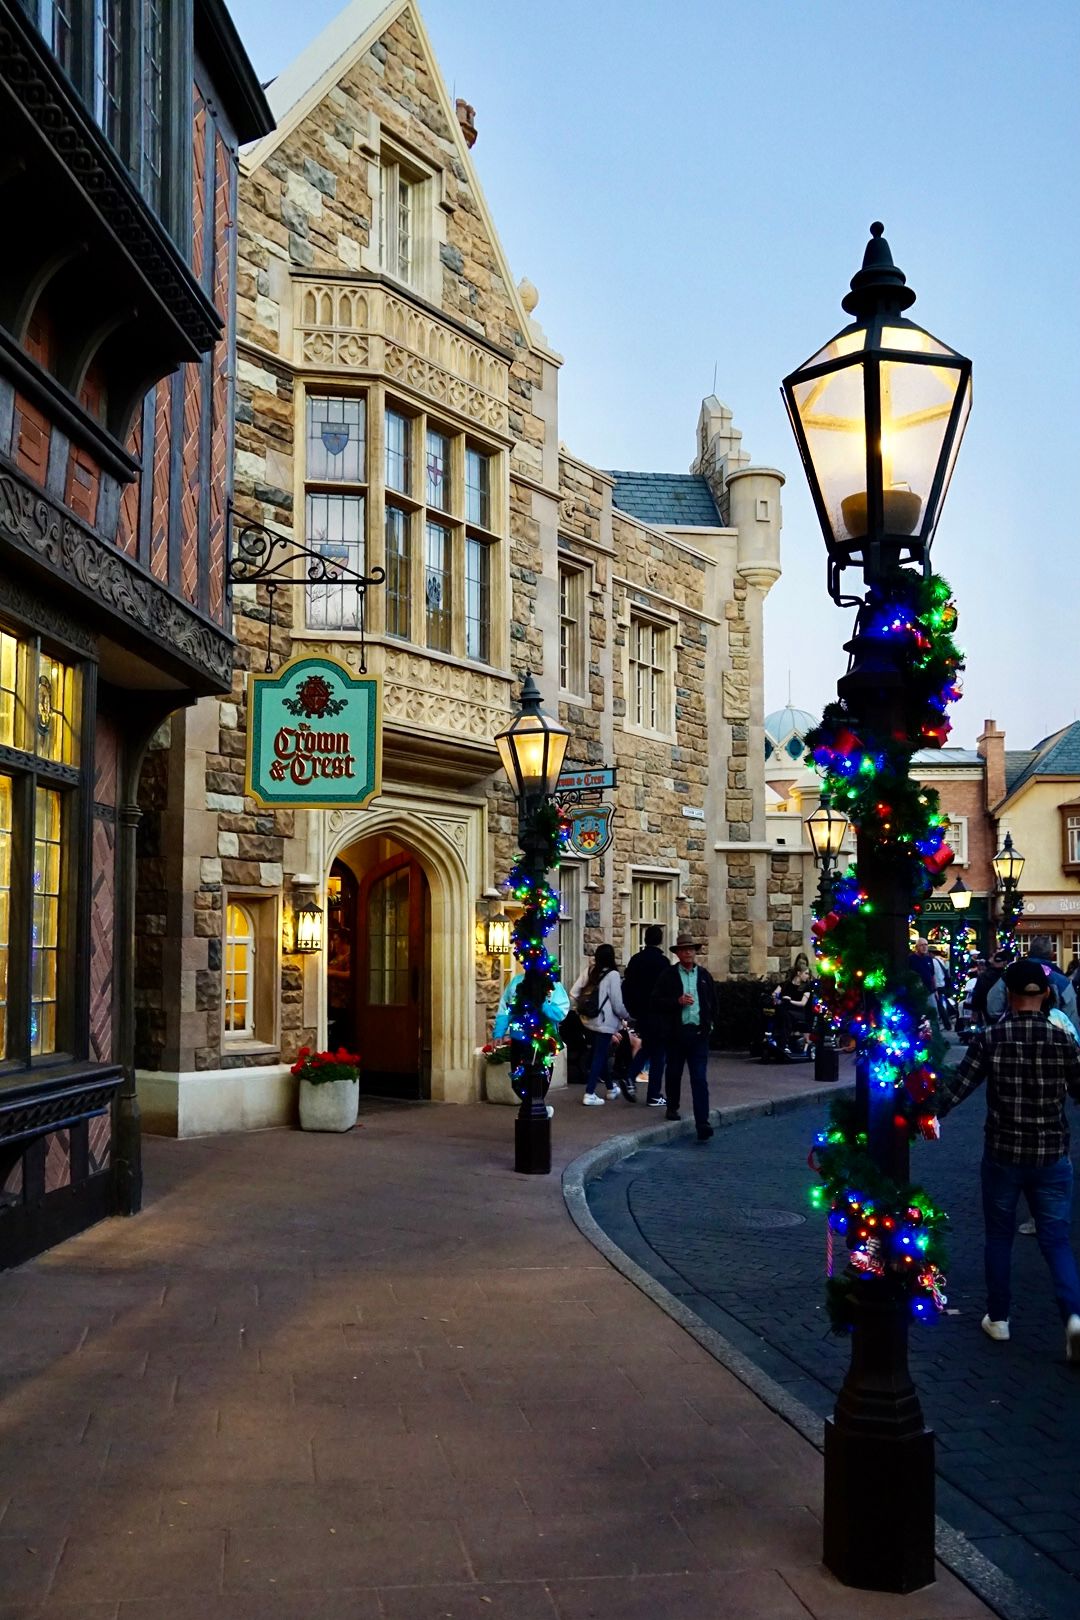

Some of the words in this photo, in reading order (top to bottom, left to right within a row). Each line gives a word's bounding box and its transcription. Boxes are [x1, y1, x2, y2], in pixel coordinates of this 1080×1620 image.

[273, 726, 350, 760] Crown
[269, 759, 291, 781] &
[290, 752, 356, 786] Crest
[559, 777, 575, 786] rown
[584, 773, 605, 786] Crest
[925, 902, 951, 912] OWN
